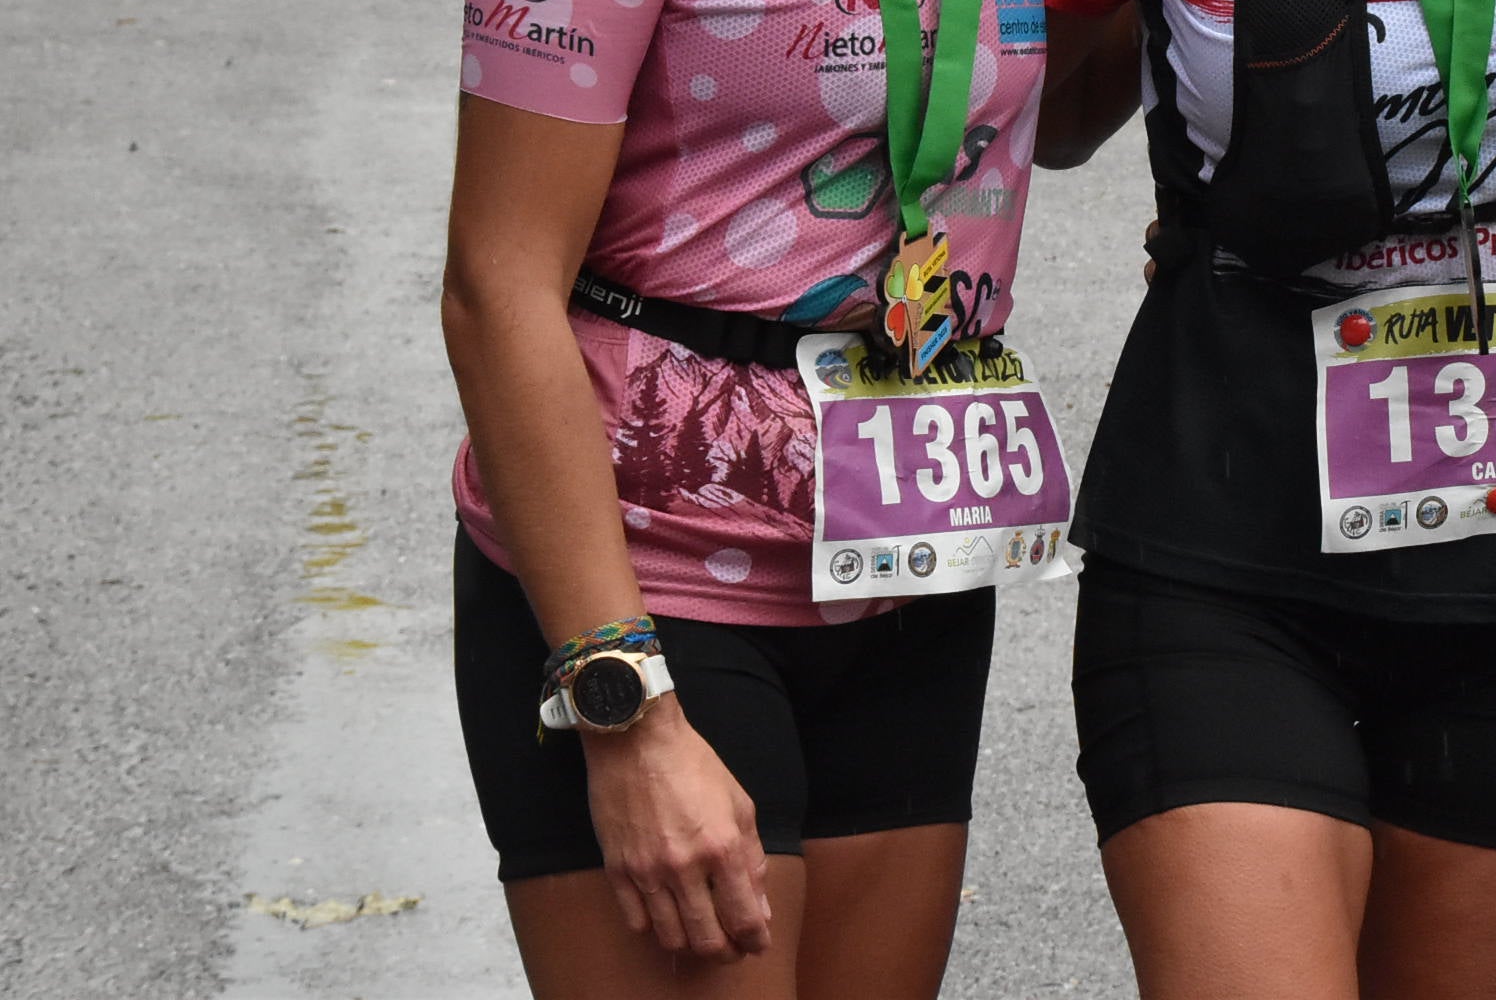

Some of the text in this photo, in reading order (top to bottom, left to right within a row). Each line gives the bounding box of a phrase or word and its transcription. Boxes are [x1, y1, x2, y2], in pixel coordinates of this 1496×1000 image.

[1000, 18, 1029, 36] centro
[814, 63, 859, 74] JAMONES
[574, 277, 644, 319] alenji
[1384, 307, 1439, 346] RUTA
[857, 400, 1044, 506] 1365
[950, 505, 993, 527] MARIA
